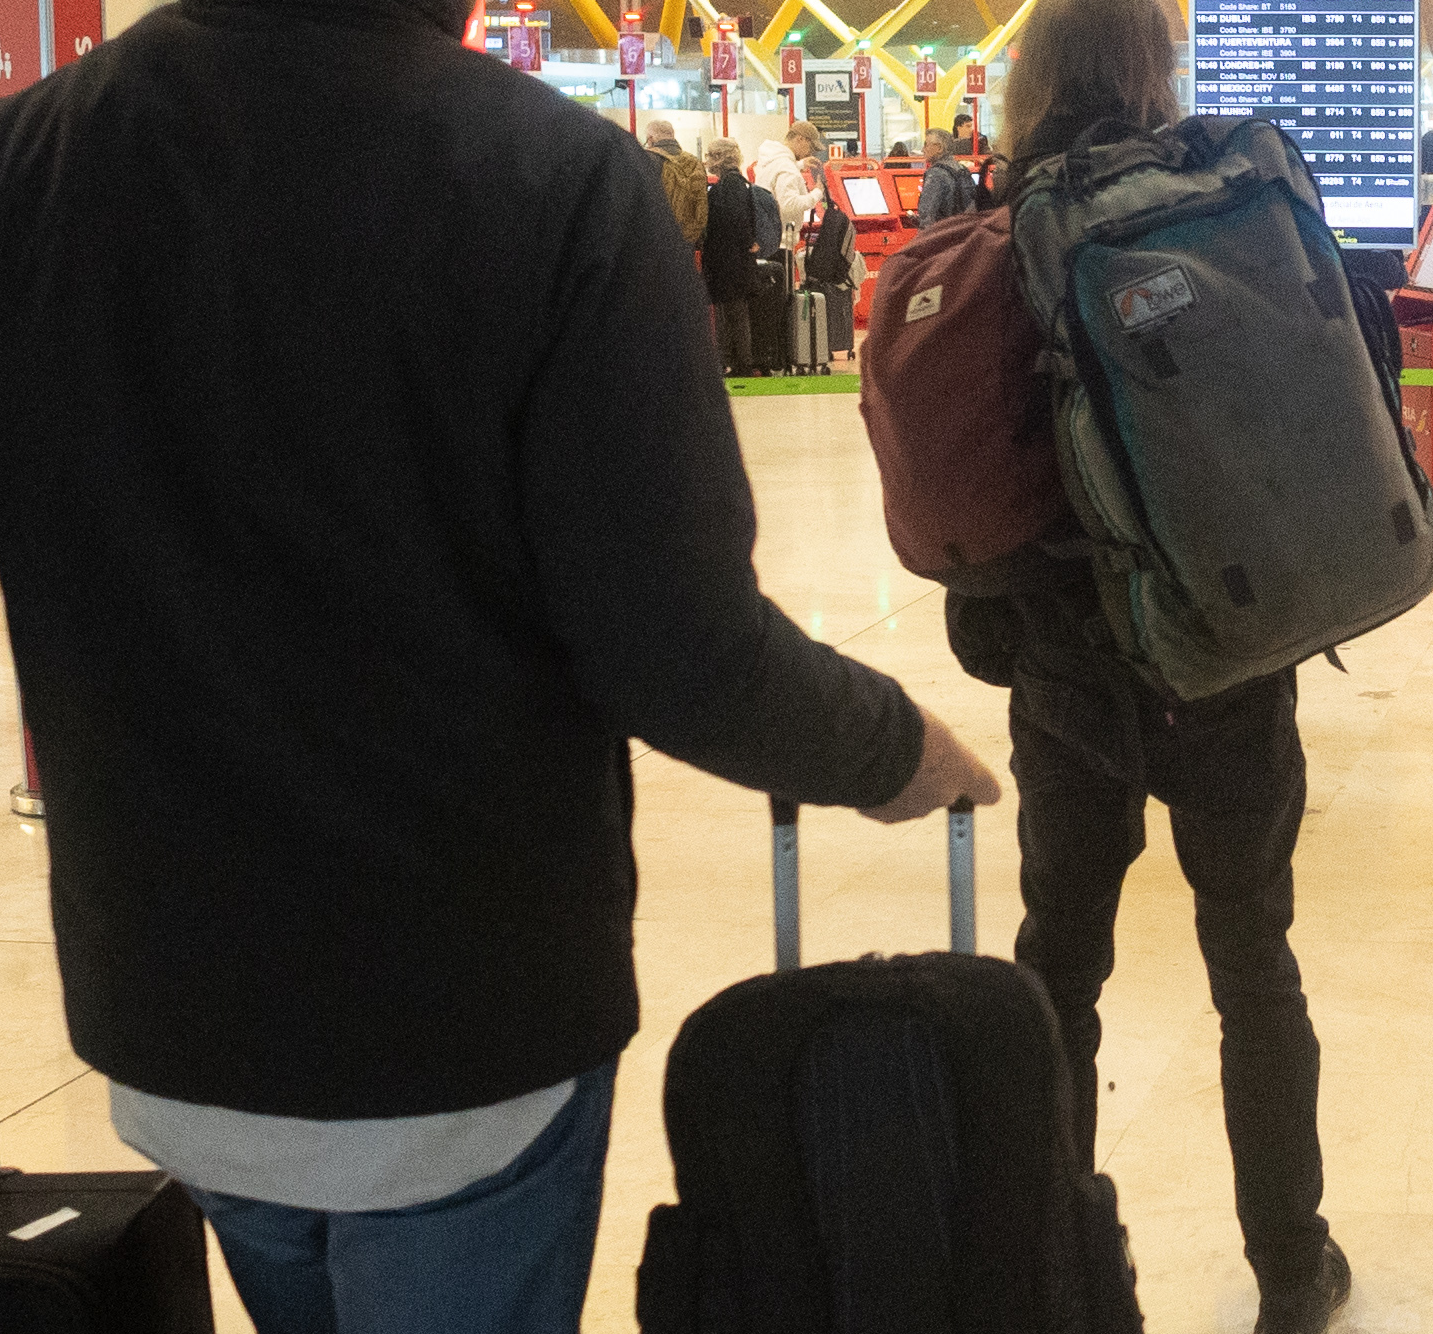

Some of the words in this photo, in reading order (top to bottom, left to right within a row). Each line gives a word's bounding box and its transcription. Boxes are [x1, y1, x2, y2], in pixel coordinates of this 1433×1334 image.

[520, 40, 530, 57] 5
[628, 43, 637, 61] 6
[720, 54, 729, 68] 7
[788, 60, 796, 73] 8
[859, 66, 867, 79] 9
[919, 71, 935, 83] 10
[969, 74, 982, 86] 11
